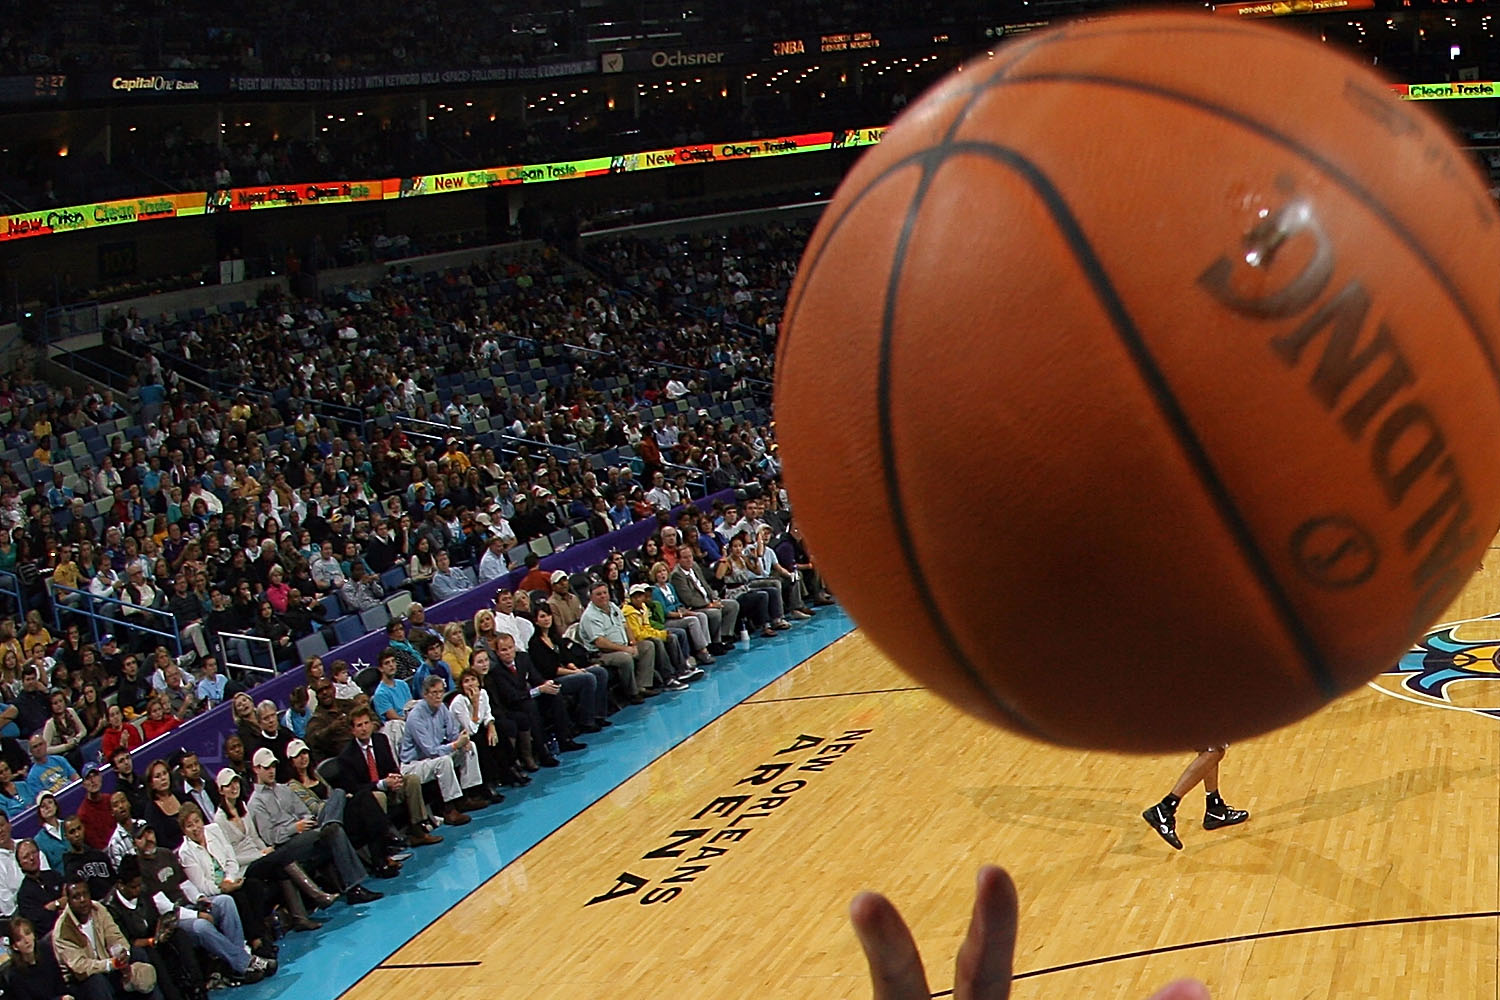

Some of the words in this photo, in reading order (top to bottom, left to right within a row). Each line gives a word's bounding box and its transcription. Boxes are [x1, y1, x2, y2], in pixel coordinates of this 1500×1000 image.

[652, 51, 725, 67] Ochsner
[176, 80, 199, 90] Bank
[1410, 86, 1453, 98] Clean
[1457, 84, 1494, 96] Taste
[646, 154, 677, 167] New
[722, 145, 761, 158] Clean
[435, 177, 463, 191] New
[507, 168, 544, 182] Clean
[547, 165, 577, 178] Taste
[8, 217, 43, 236] New
[798, 729, 873, 772] NEW
[584, 734, 825, 907] ARENA
[640, 780, 807, 905] ORLEANS
